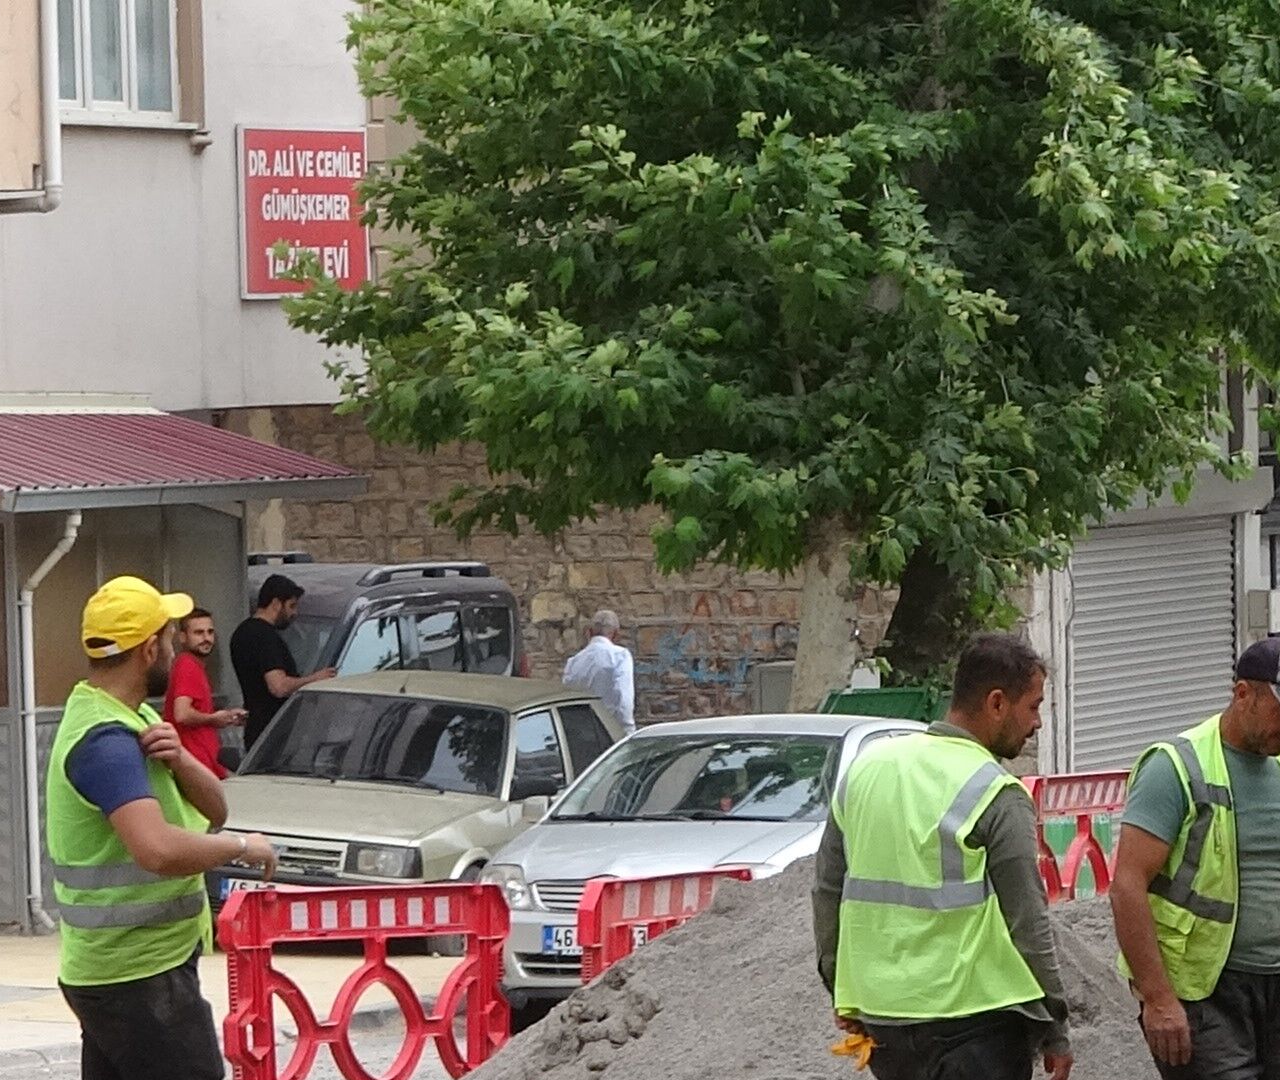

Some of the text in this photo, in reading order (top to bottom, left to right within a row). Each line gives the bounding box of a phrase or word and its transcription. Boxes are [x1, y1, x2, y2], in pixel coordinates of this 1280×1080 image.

[248, 144, 362, 178] DR. ALİ VE CEMİLE
[262, 188, 350, 225] GÜMÜŞKEMER
[324, 239, 350, 279] EVİ
[555, 929, 573, 947] 46
